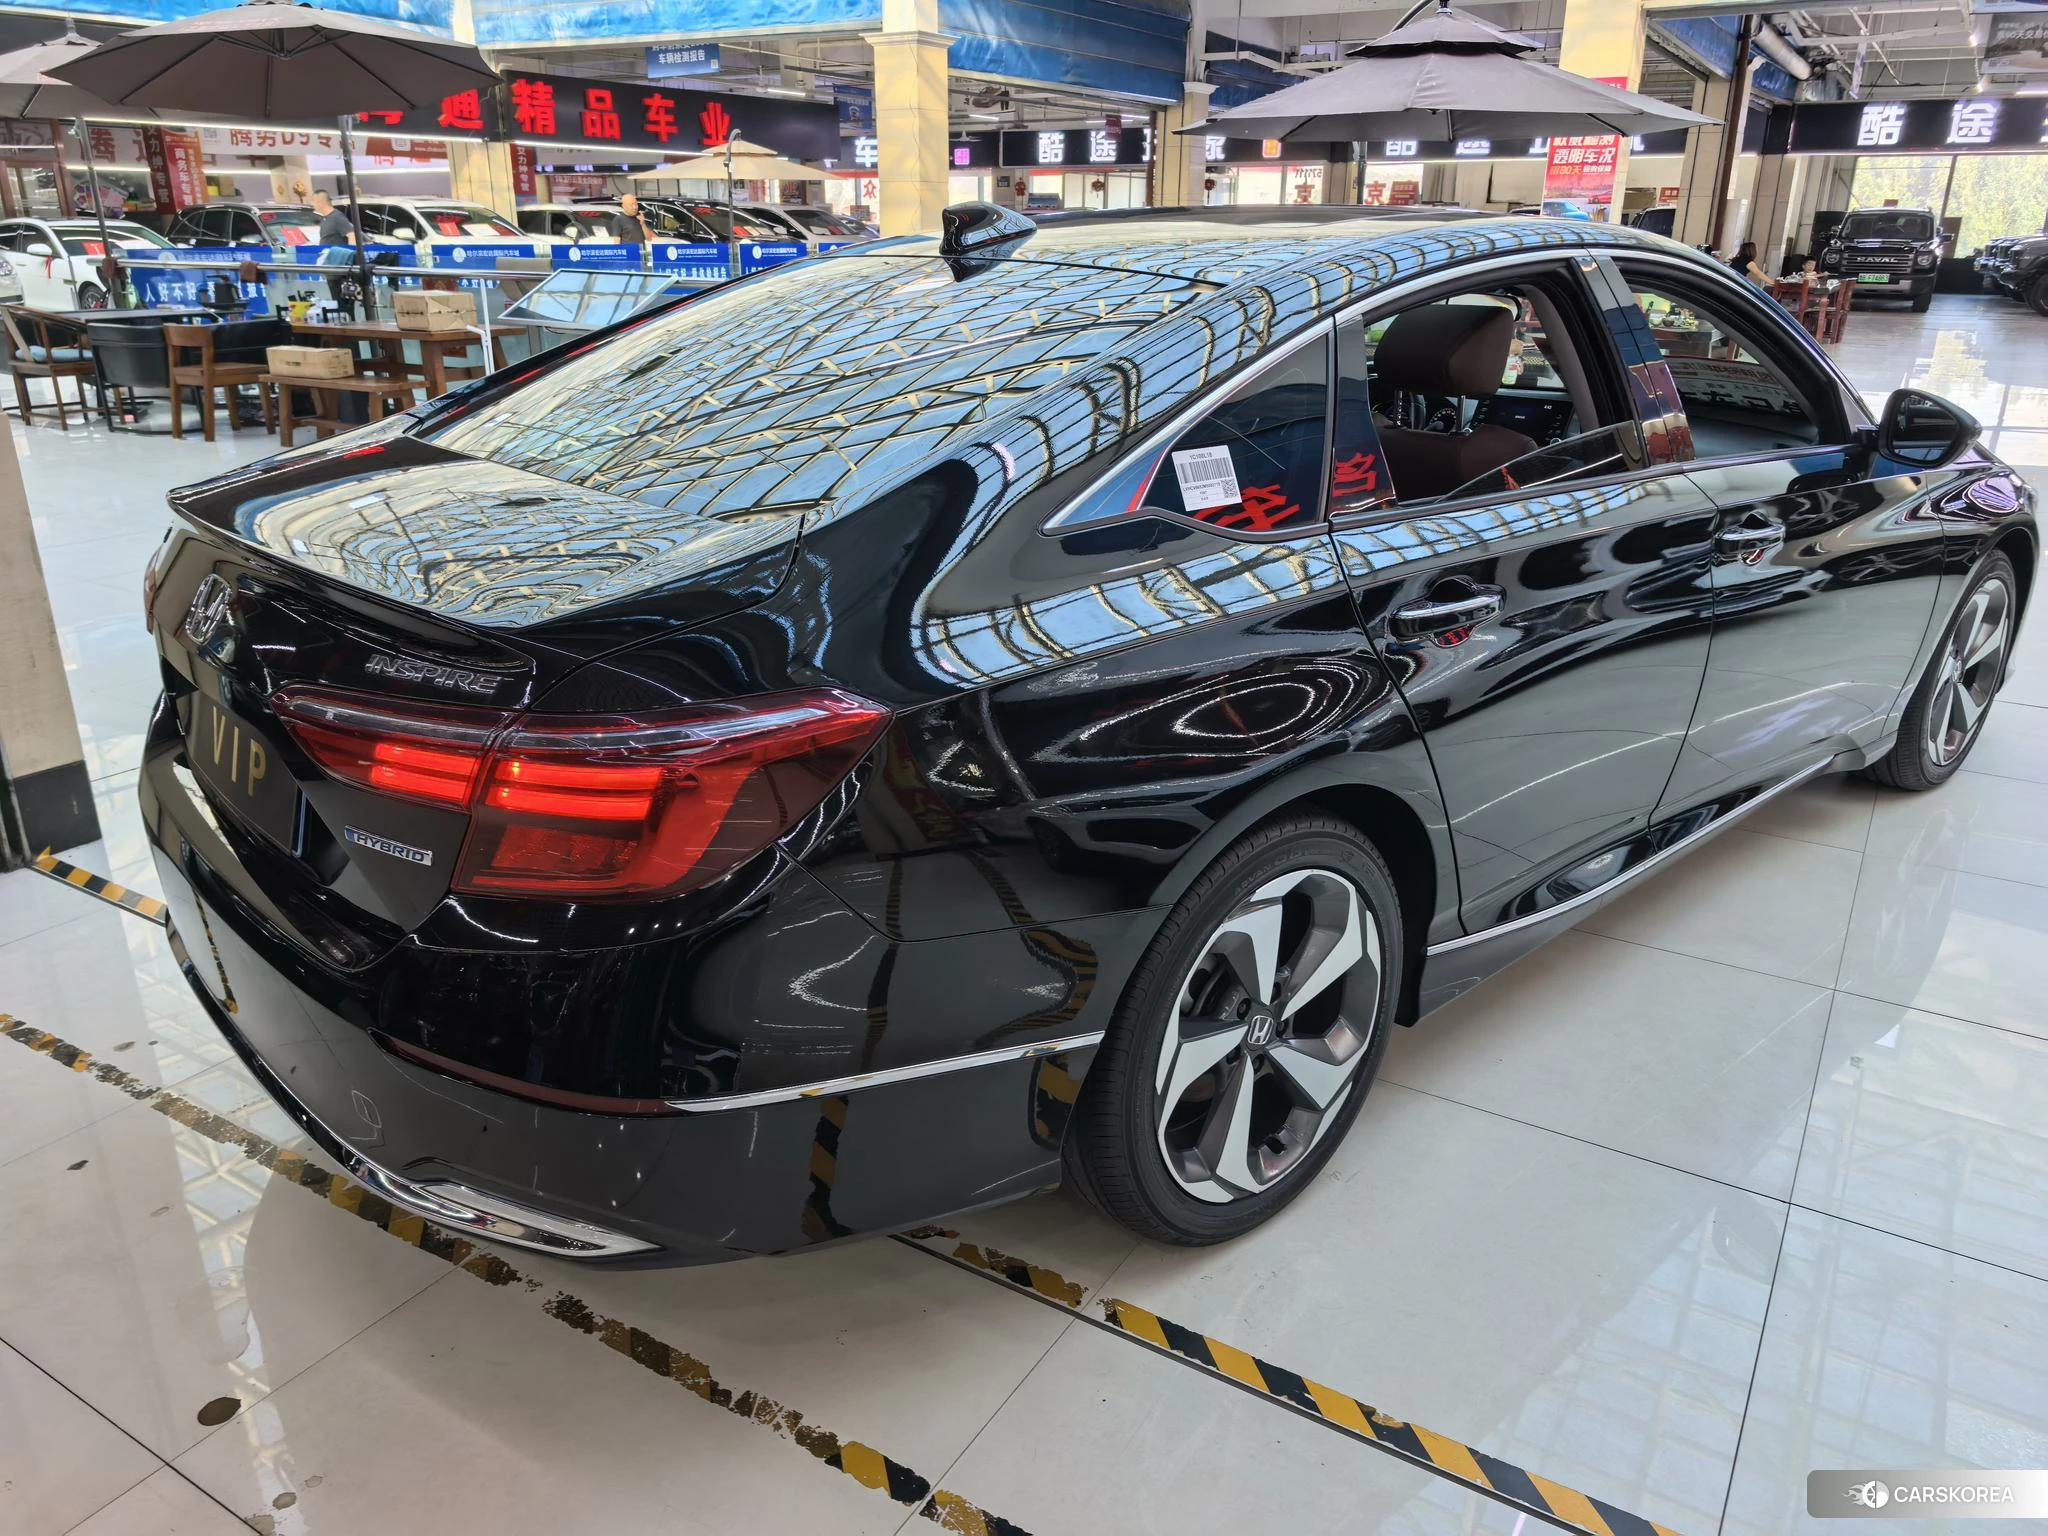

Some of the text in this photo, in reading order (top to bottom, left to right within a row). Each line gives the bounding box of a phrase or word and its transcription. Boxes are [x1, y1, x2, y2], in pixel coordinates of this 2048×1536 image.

[658, 50, 706, 64] 车辆检测报告
[512, 78, 731, 146] 精品车业
[1857, 103, 2048, 146] 酷途
[1553, 148, 1616, 164] 透明车况
[365, 654, 502, 694] INSPIRE
[212, 705, 267, 797] VIP
[356, 834, 427, 863] HYBRID
